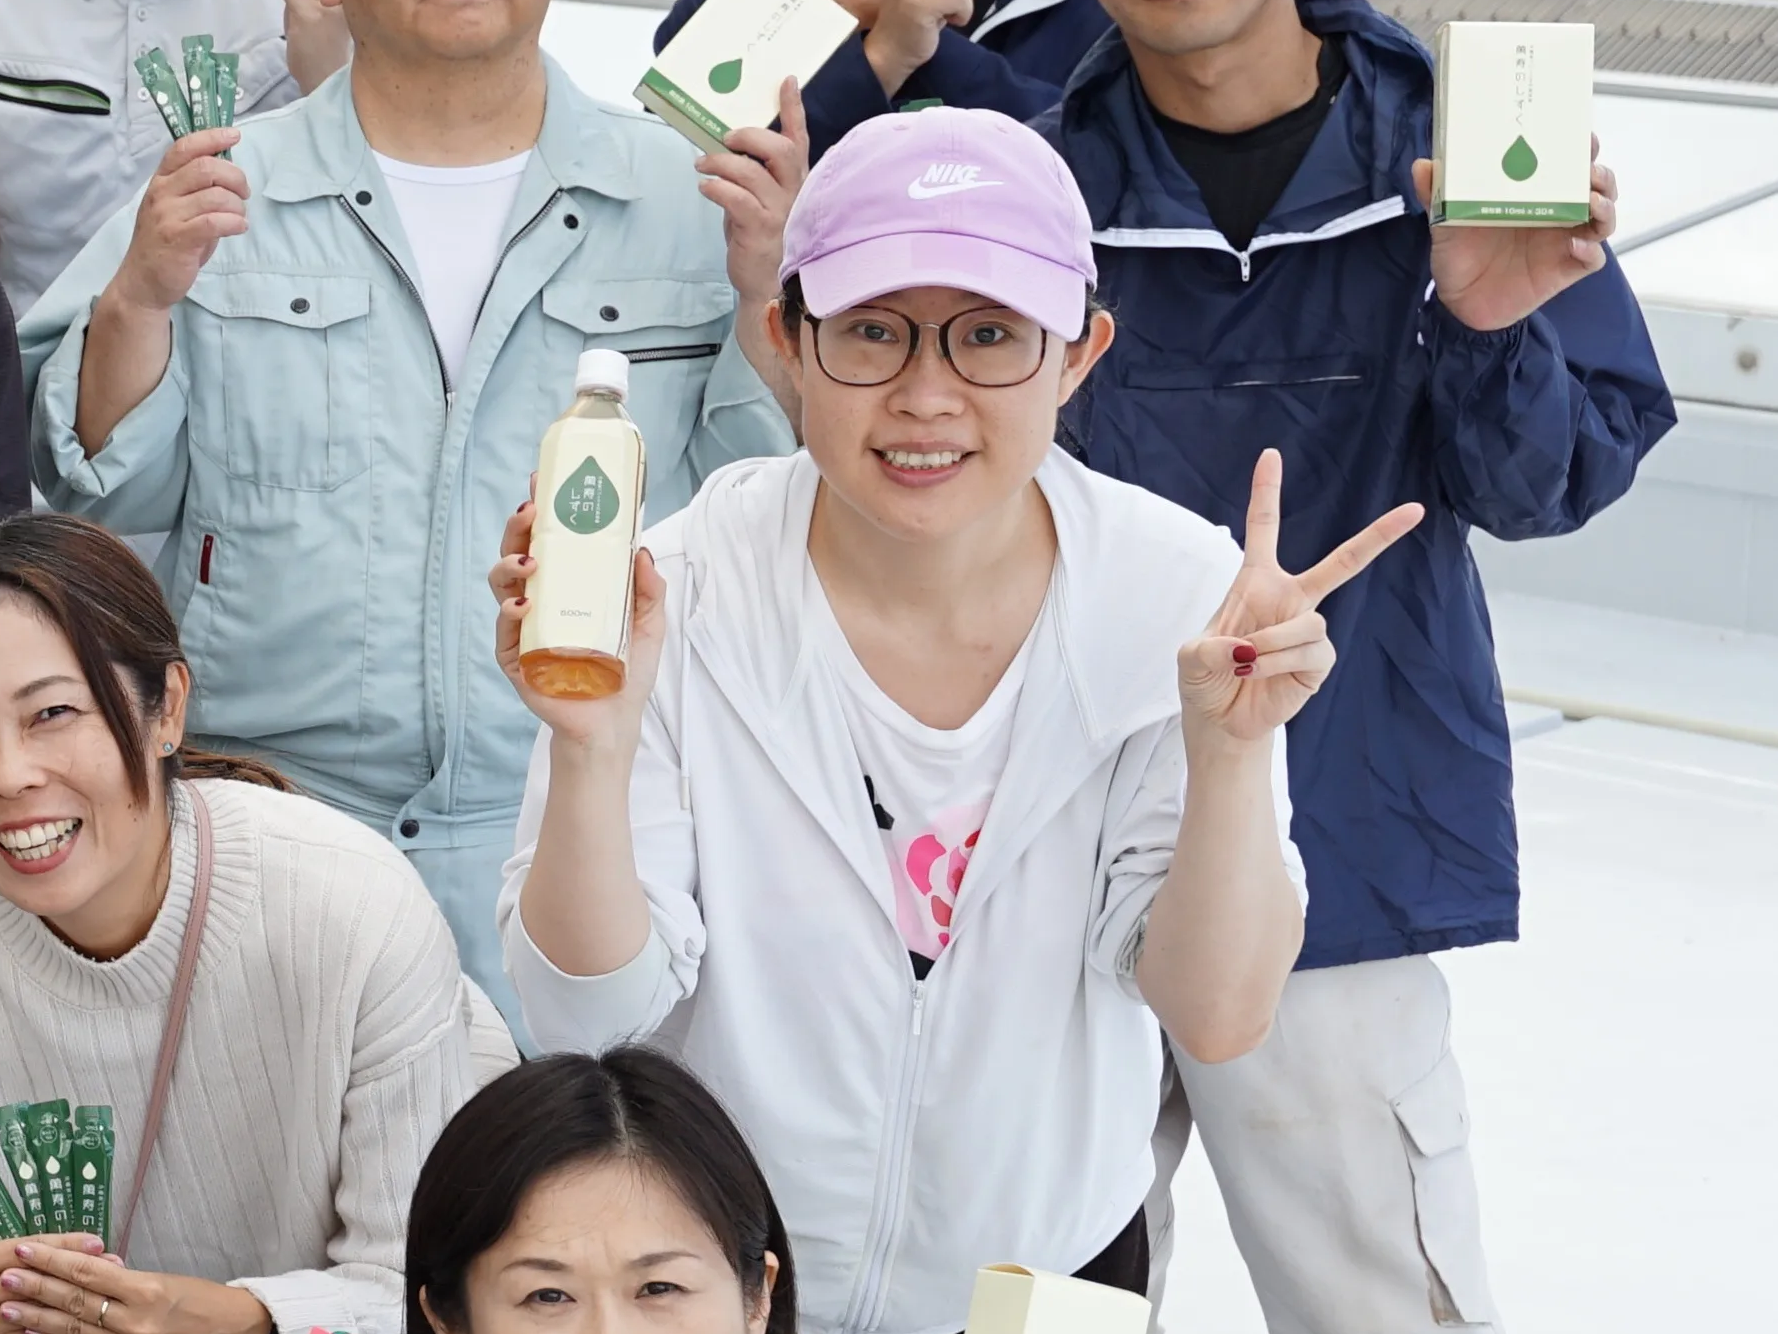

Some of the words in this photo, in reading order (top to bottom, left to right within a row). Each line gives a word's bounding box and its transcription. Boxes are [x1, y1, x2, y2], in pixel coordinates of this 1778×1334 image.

[923, 163, 982, 185] NIKE
[568, 488, 581, 525] しずく
[24, 1182, 47, 1233] 萬寿の
[49, 1178, 67, 1233] 萬寿の
